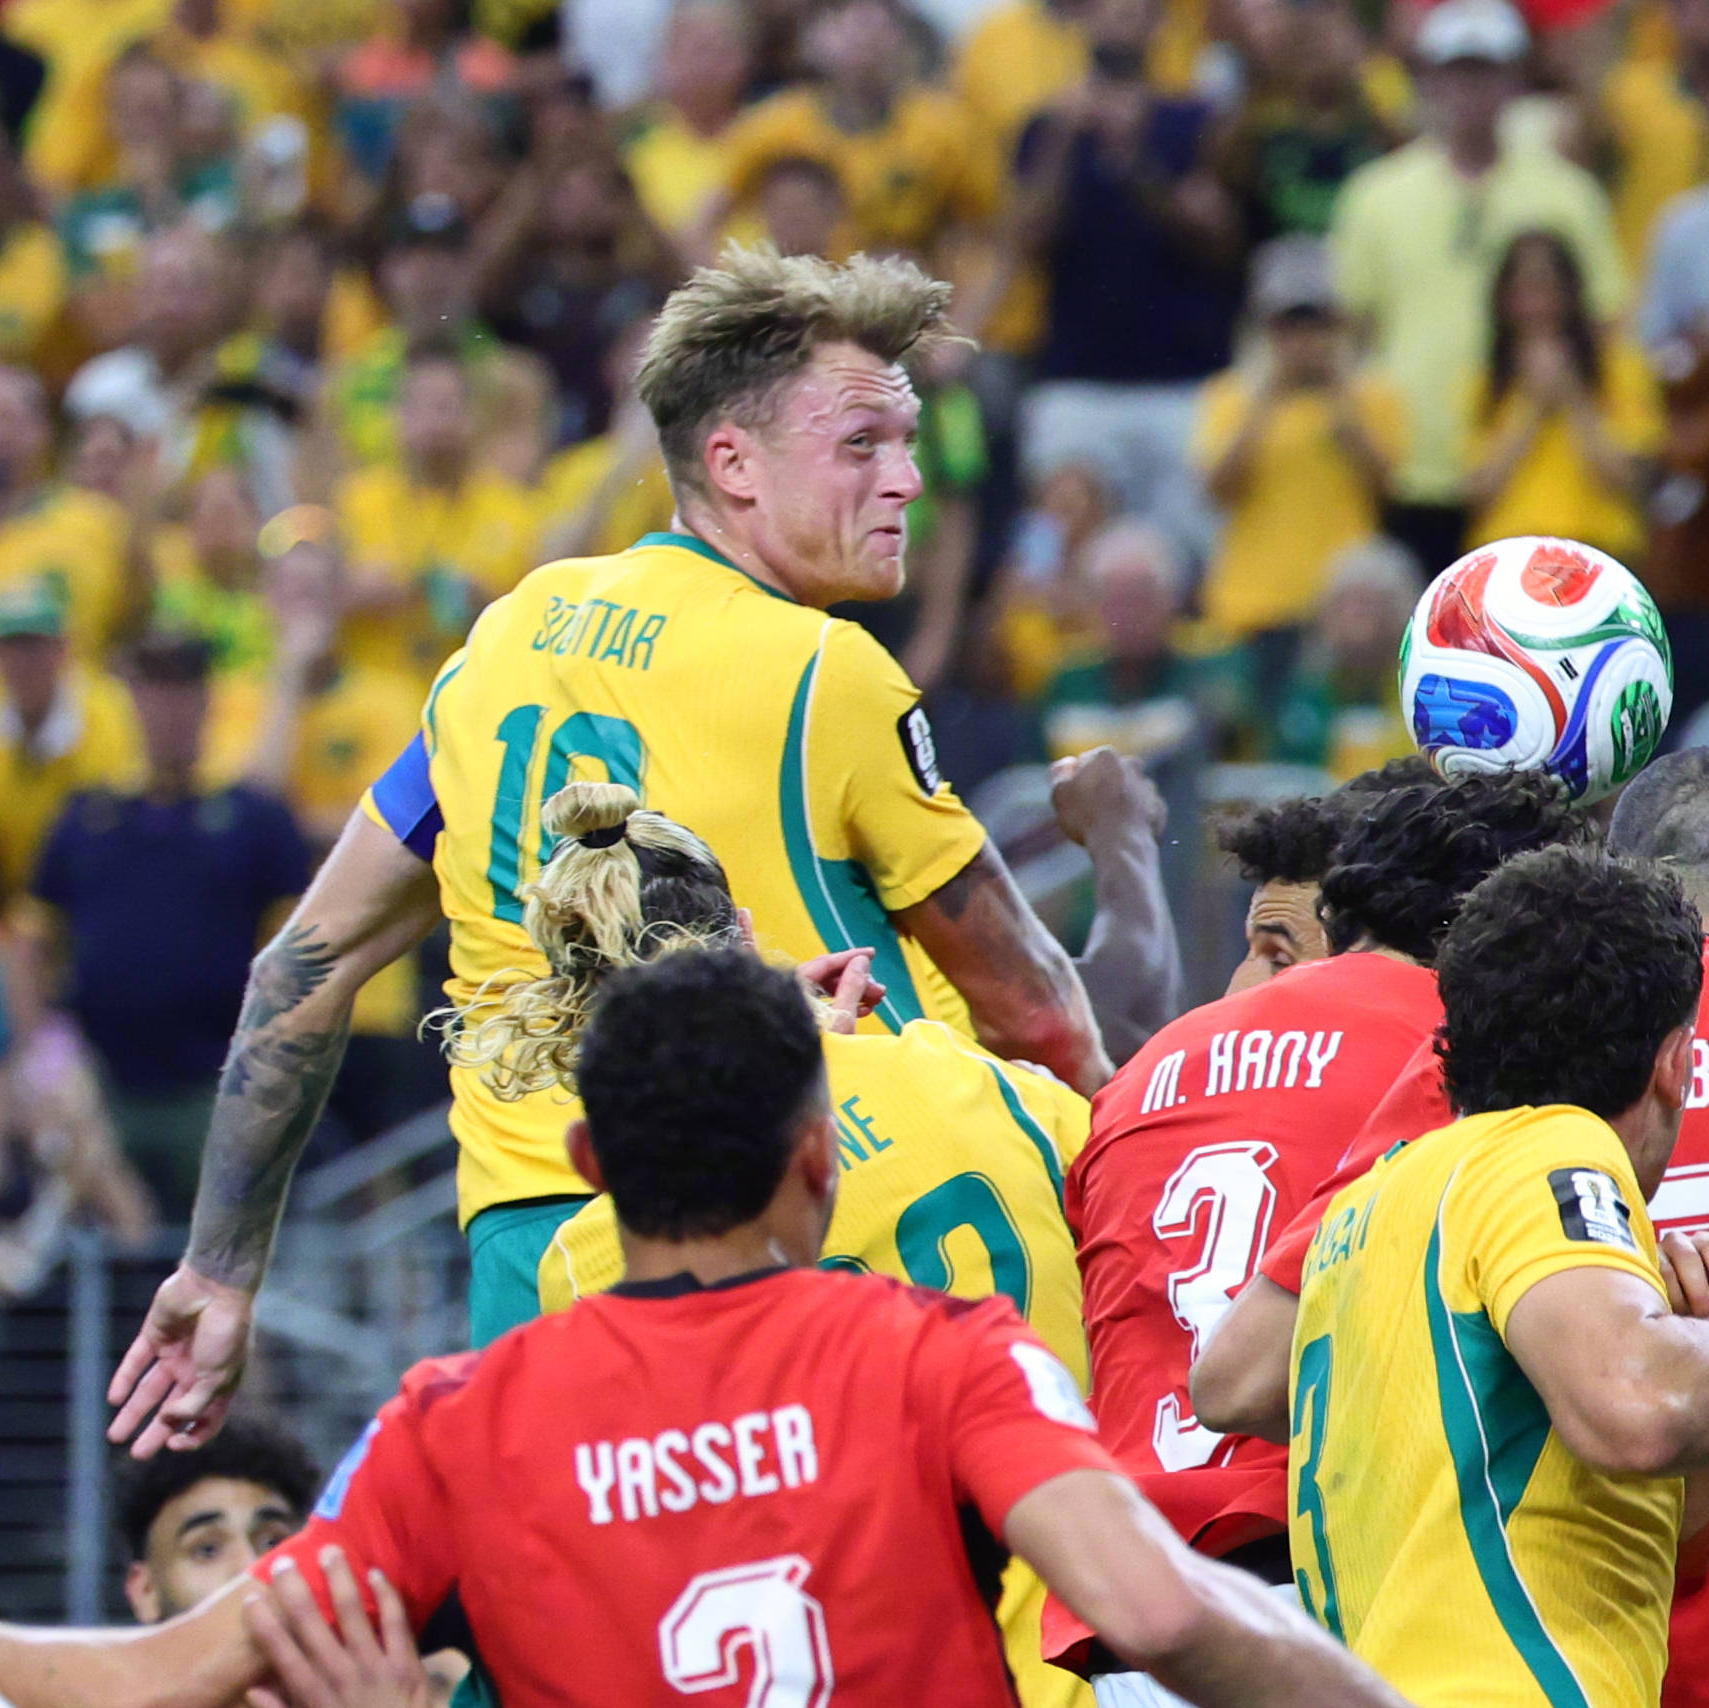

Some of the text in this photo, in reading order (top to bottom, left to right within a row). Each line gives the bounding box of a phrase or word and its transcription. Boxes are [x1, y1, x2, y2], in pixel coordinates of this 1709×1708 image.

[1140, 1030, 1344, 1115] M. HANY
[575, 1403, 819, 1525] YASSER
